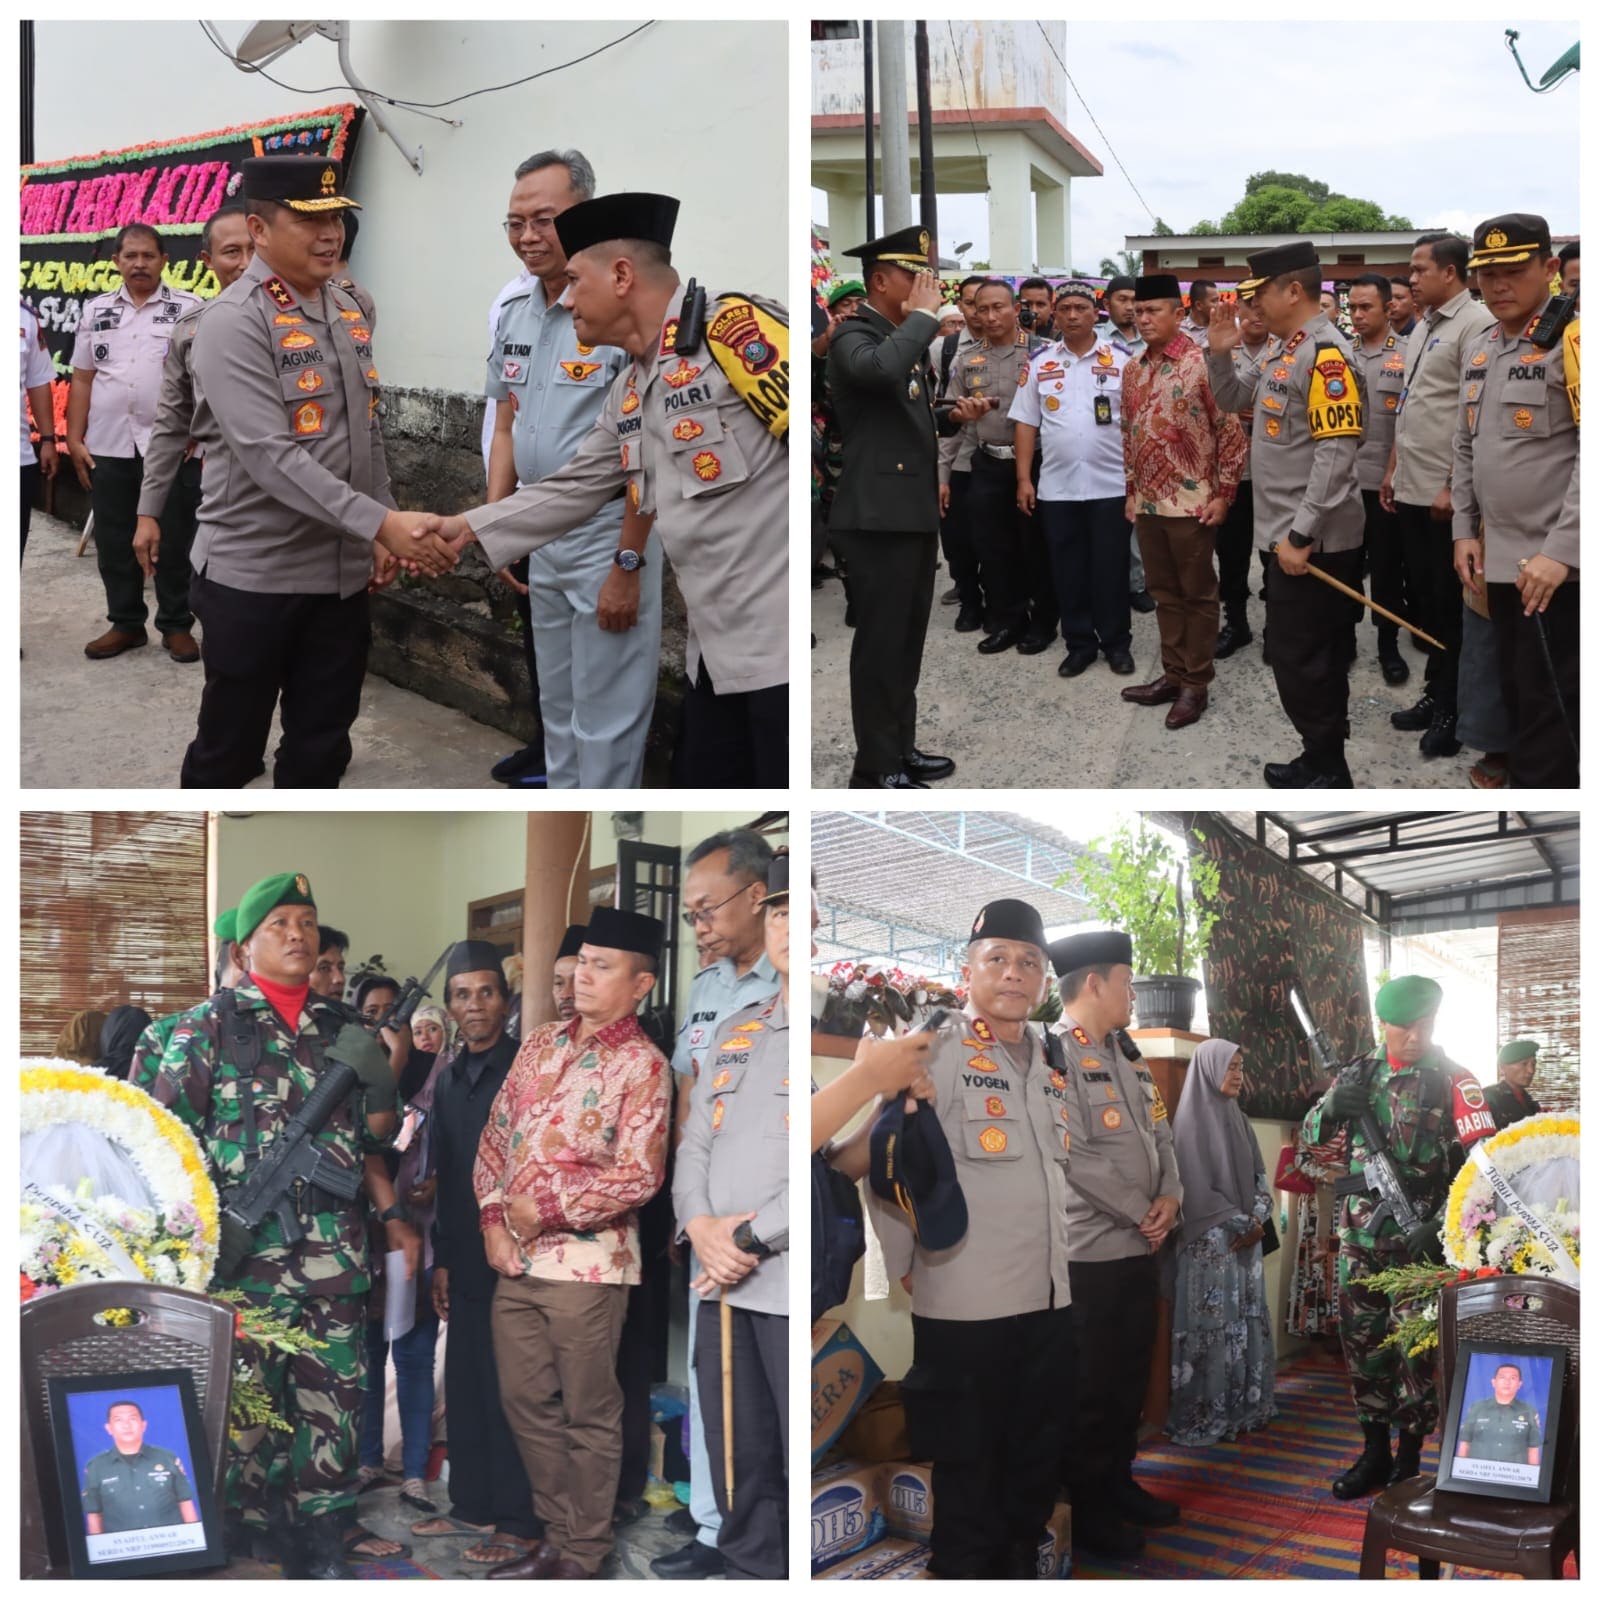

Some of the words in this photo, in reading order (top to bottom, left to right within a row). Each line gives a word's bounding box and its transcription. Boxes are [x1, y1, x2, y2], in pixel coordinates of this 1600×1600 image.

[712, 307, 750, 337] POLRES
[282, 349, 323, 368] AGUNG
[1319, 361, 1345, 370] POLDA
[1508, 366, 1546, 381] POLRI
[665, 384, 711, 412] POLRI
[1327, 404, 1353, 429] OPS
[962, 1074, 1010, 1091] YOGEN
